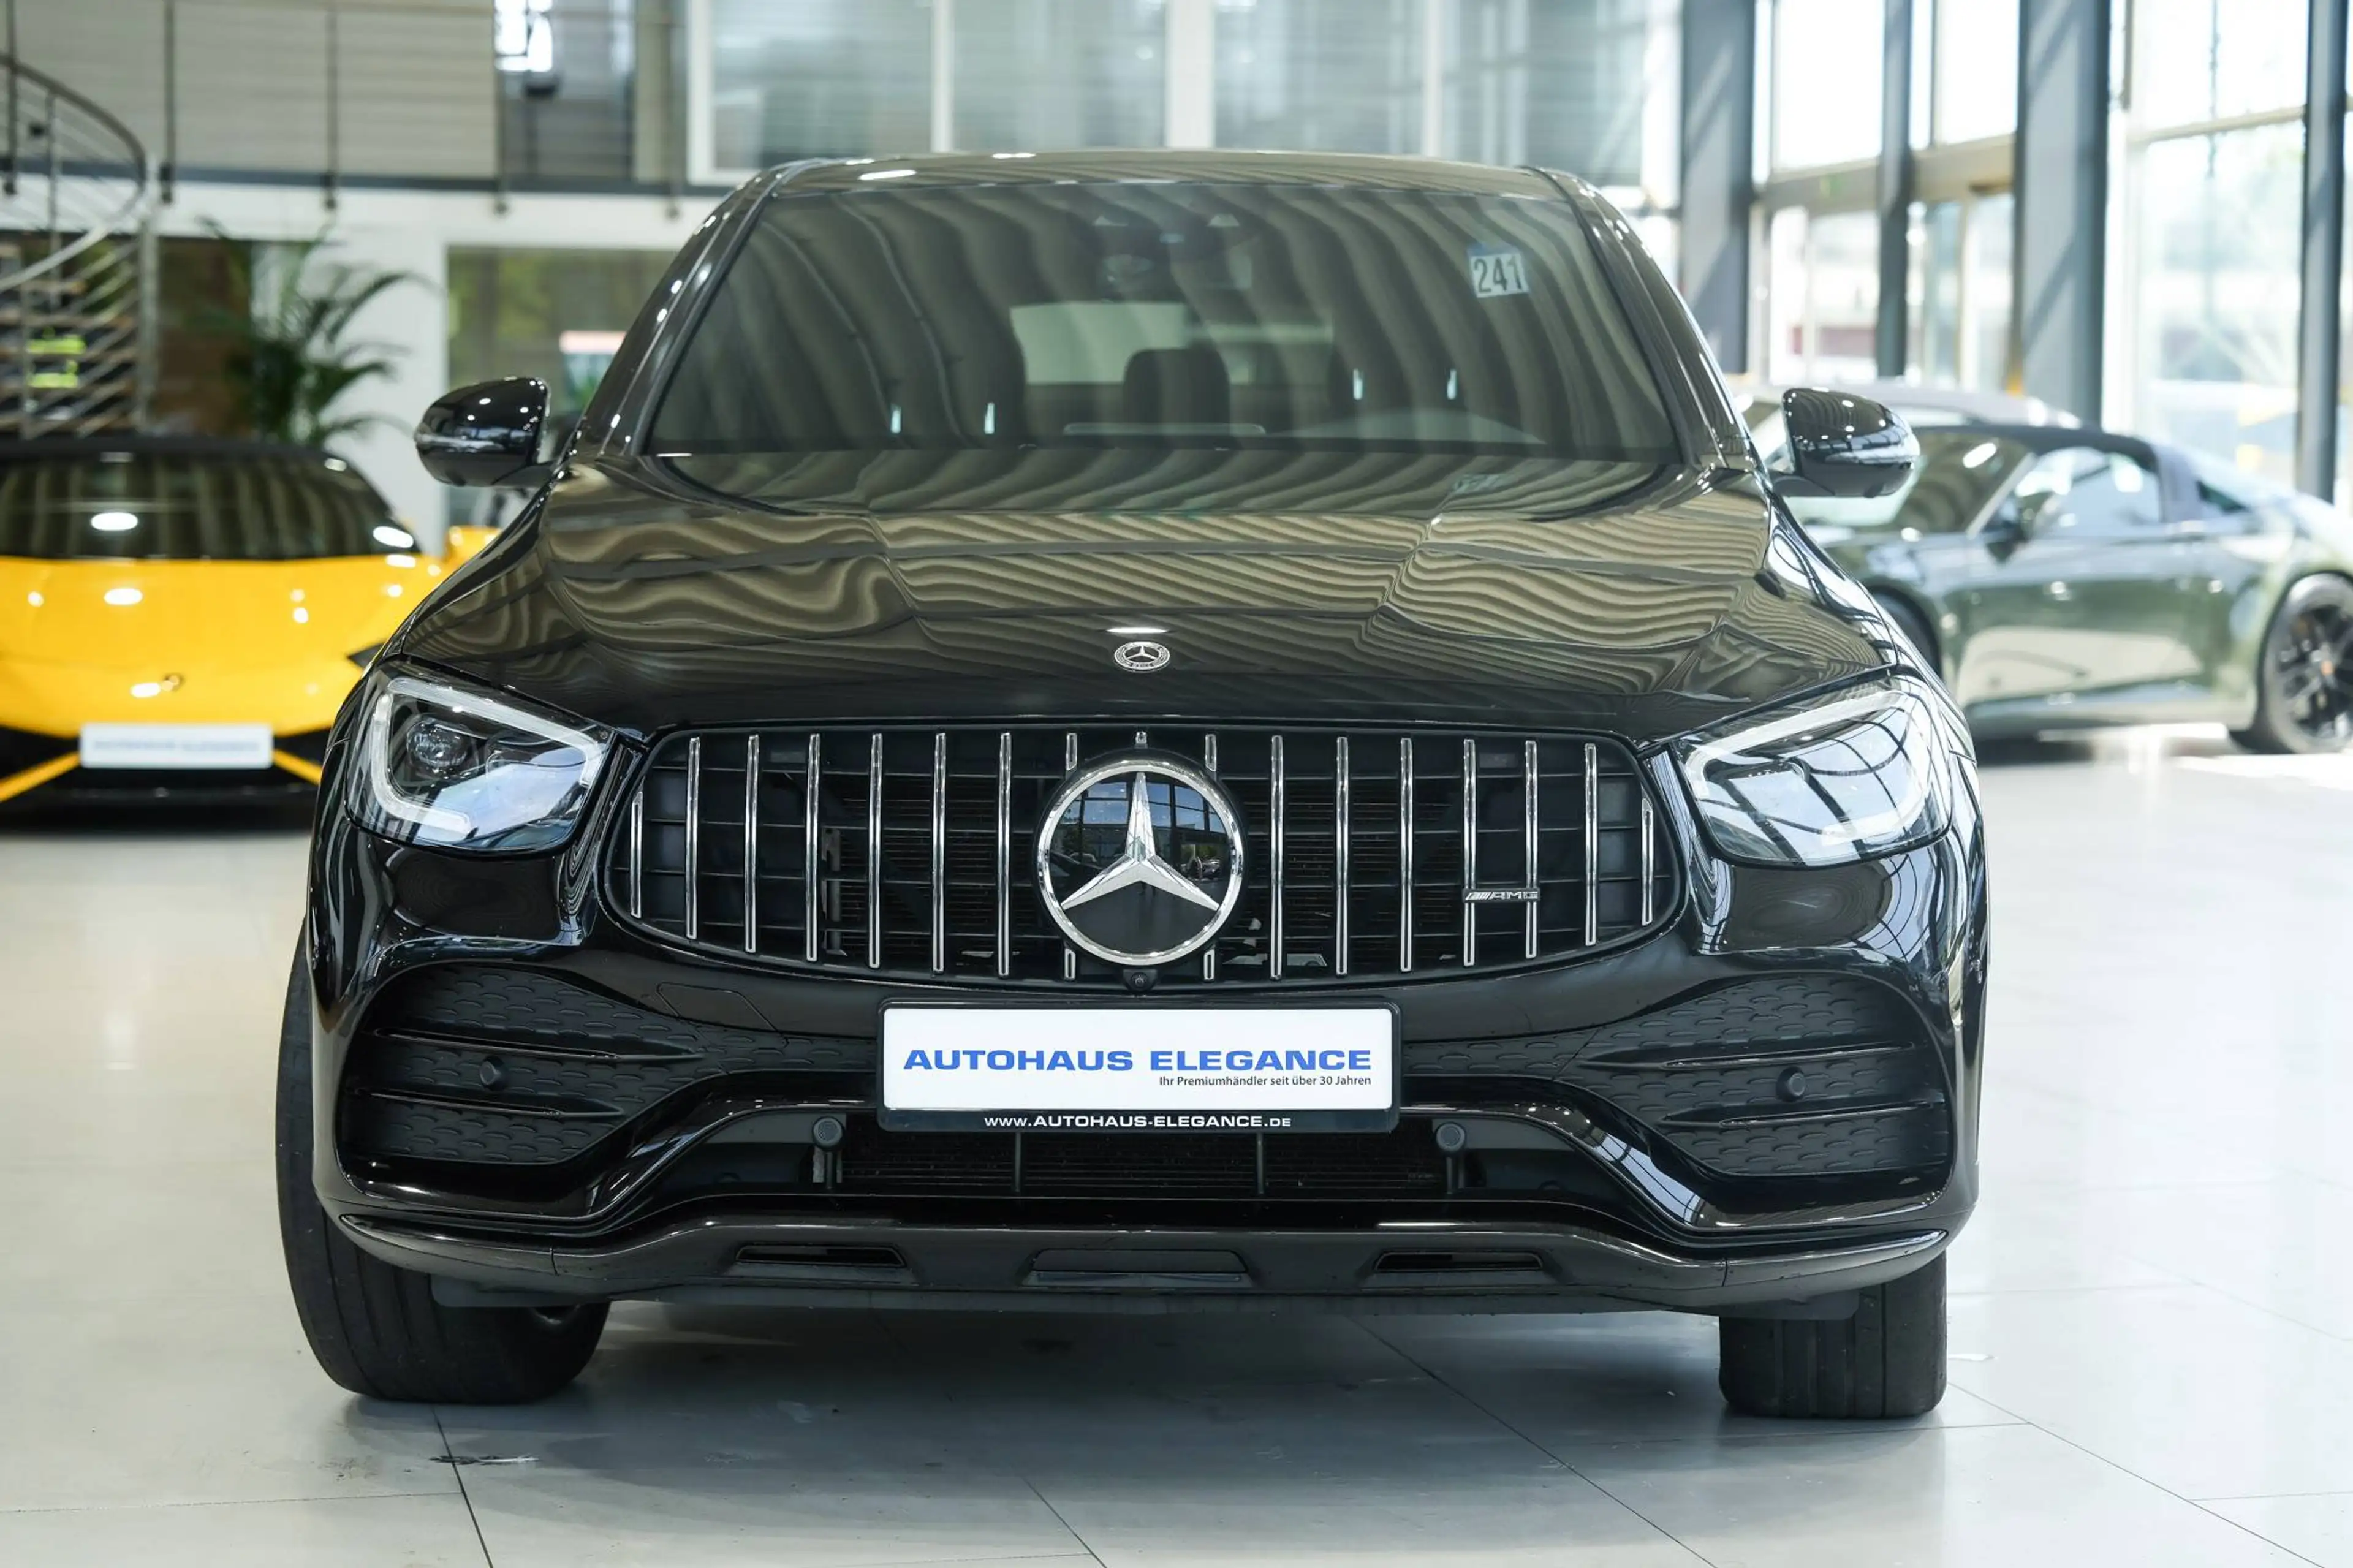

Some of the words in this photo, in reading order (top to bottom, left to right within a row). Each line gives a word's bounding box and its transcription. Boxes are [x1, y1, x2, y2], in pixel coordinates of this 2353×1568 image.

[1474, 256, 1523, 293] 241
[1488, 891, 1539, 900] AMG
[903, 1050, 1133, 1072] AUTOHAUS
[1150, 1050, 1371, 1071] ELEGANCE
[1159, 1076, 1175, 1086] Ihr
[1177, 1075, 1268, 1086] Premiumhändler
[1270, 1076, 1289, 1086] seit
[1292, 1075, 1317, 1085] über
[1320, 1076, 1333, 1085] 30
[1335, 1075, 1371, 1085] Jahren
